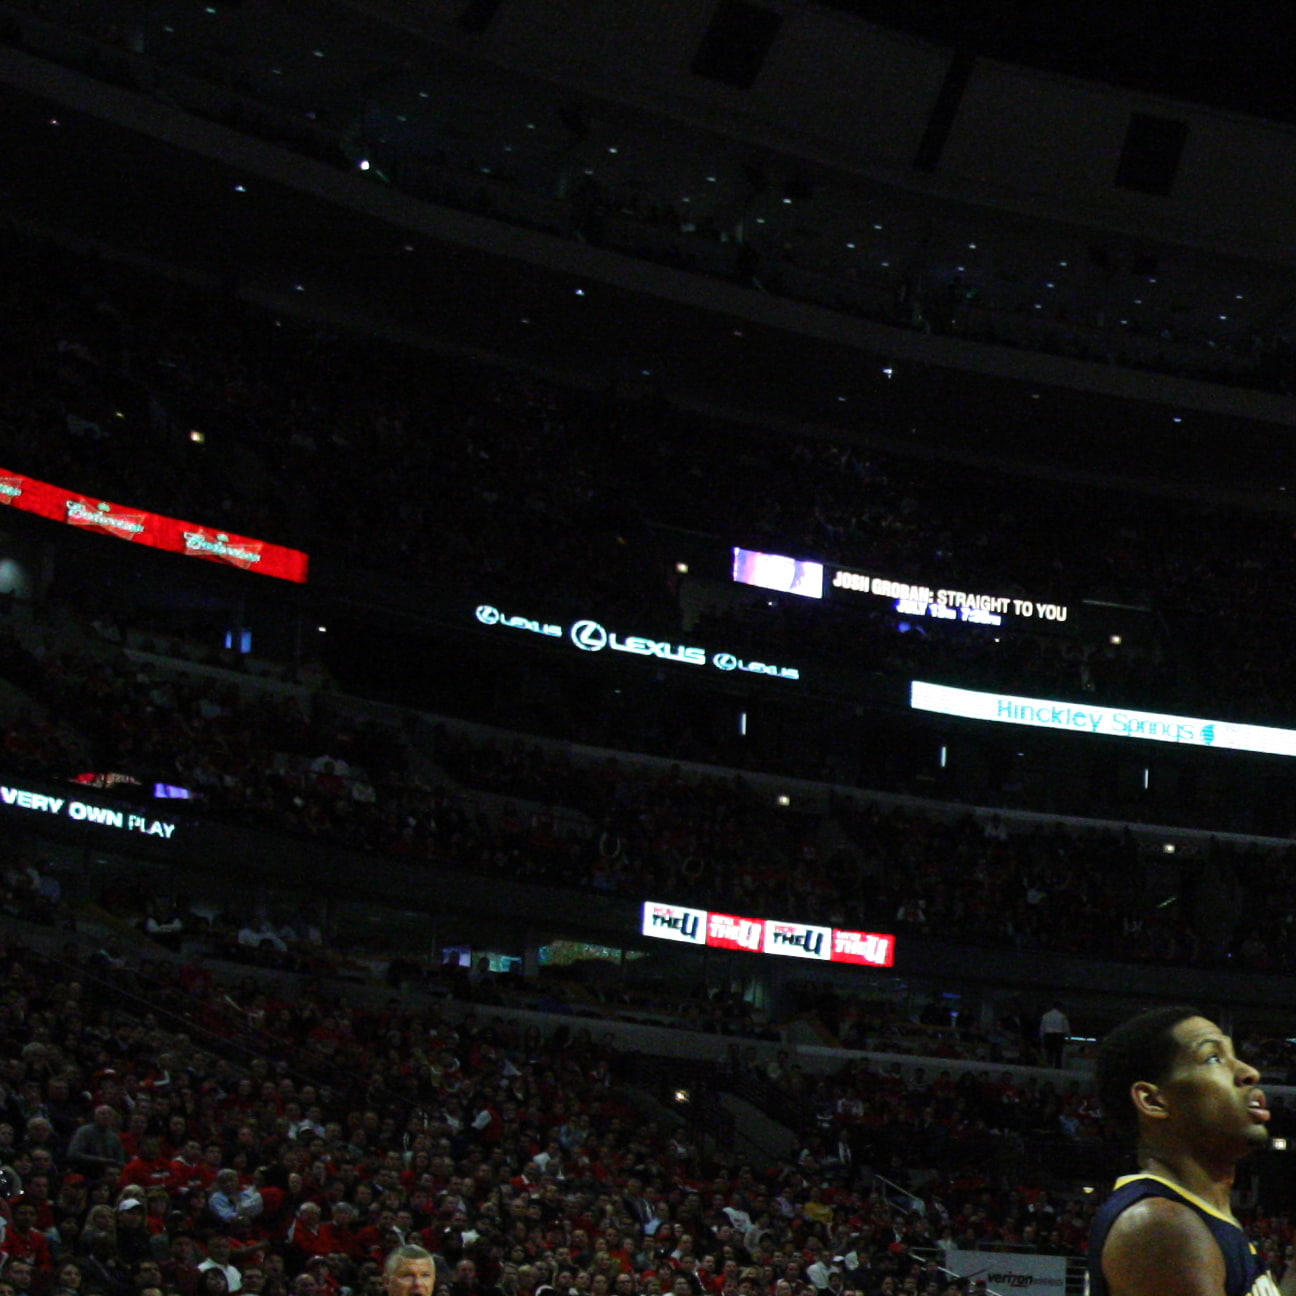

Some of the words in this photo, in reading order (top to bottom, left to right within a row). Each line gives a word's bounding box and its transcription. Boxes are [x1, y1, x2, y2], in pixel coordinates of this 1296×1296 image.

[833, 571, 870, 592] JOSH
[936, 589, 1010, 614] STRAIGHT
[1013, 600, 1033, 617] TO
[1036, 603, 1068, 622] YOU
[500, 612, 562, 637] LEXUS
[609, 633, 706, 665] LEXUS
[738, 659, 799, 680] LEXUS
[997, 699, 1102, 733] Hinckley
[1112, 714, 1195, 743] Springs
[0, 786, 65, 814] VERY
[69, 802, 124, 828] OWN
[128, 814, 176, 839] PLAY
[652, 913, 682, 931] THE
[680, 912, 700, 939] U
[737, 919, 762, 950] U
[773, 931, 804, 947] THE
[803, 930, 824, 956] U
[864, 934, 889, 965] U
[987, 1271, 1033, 1288] verizon
